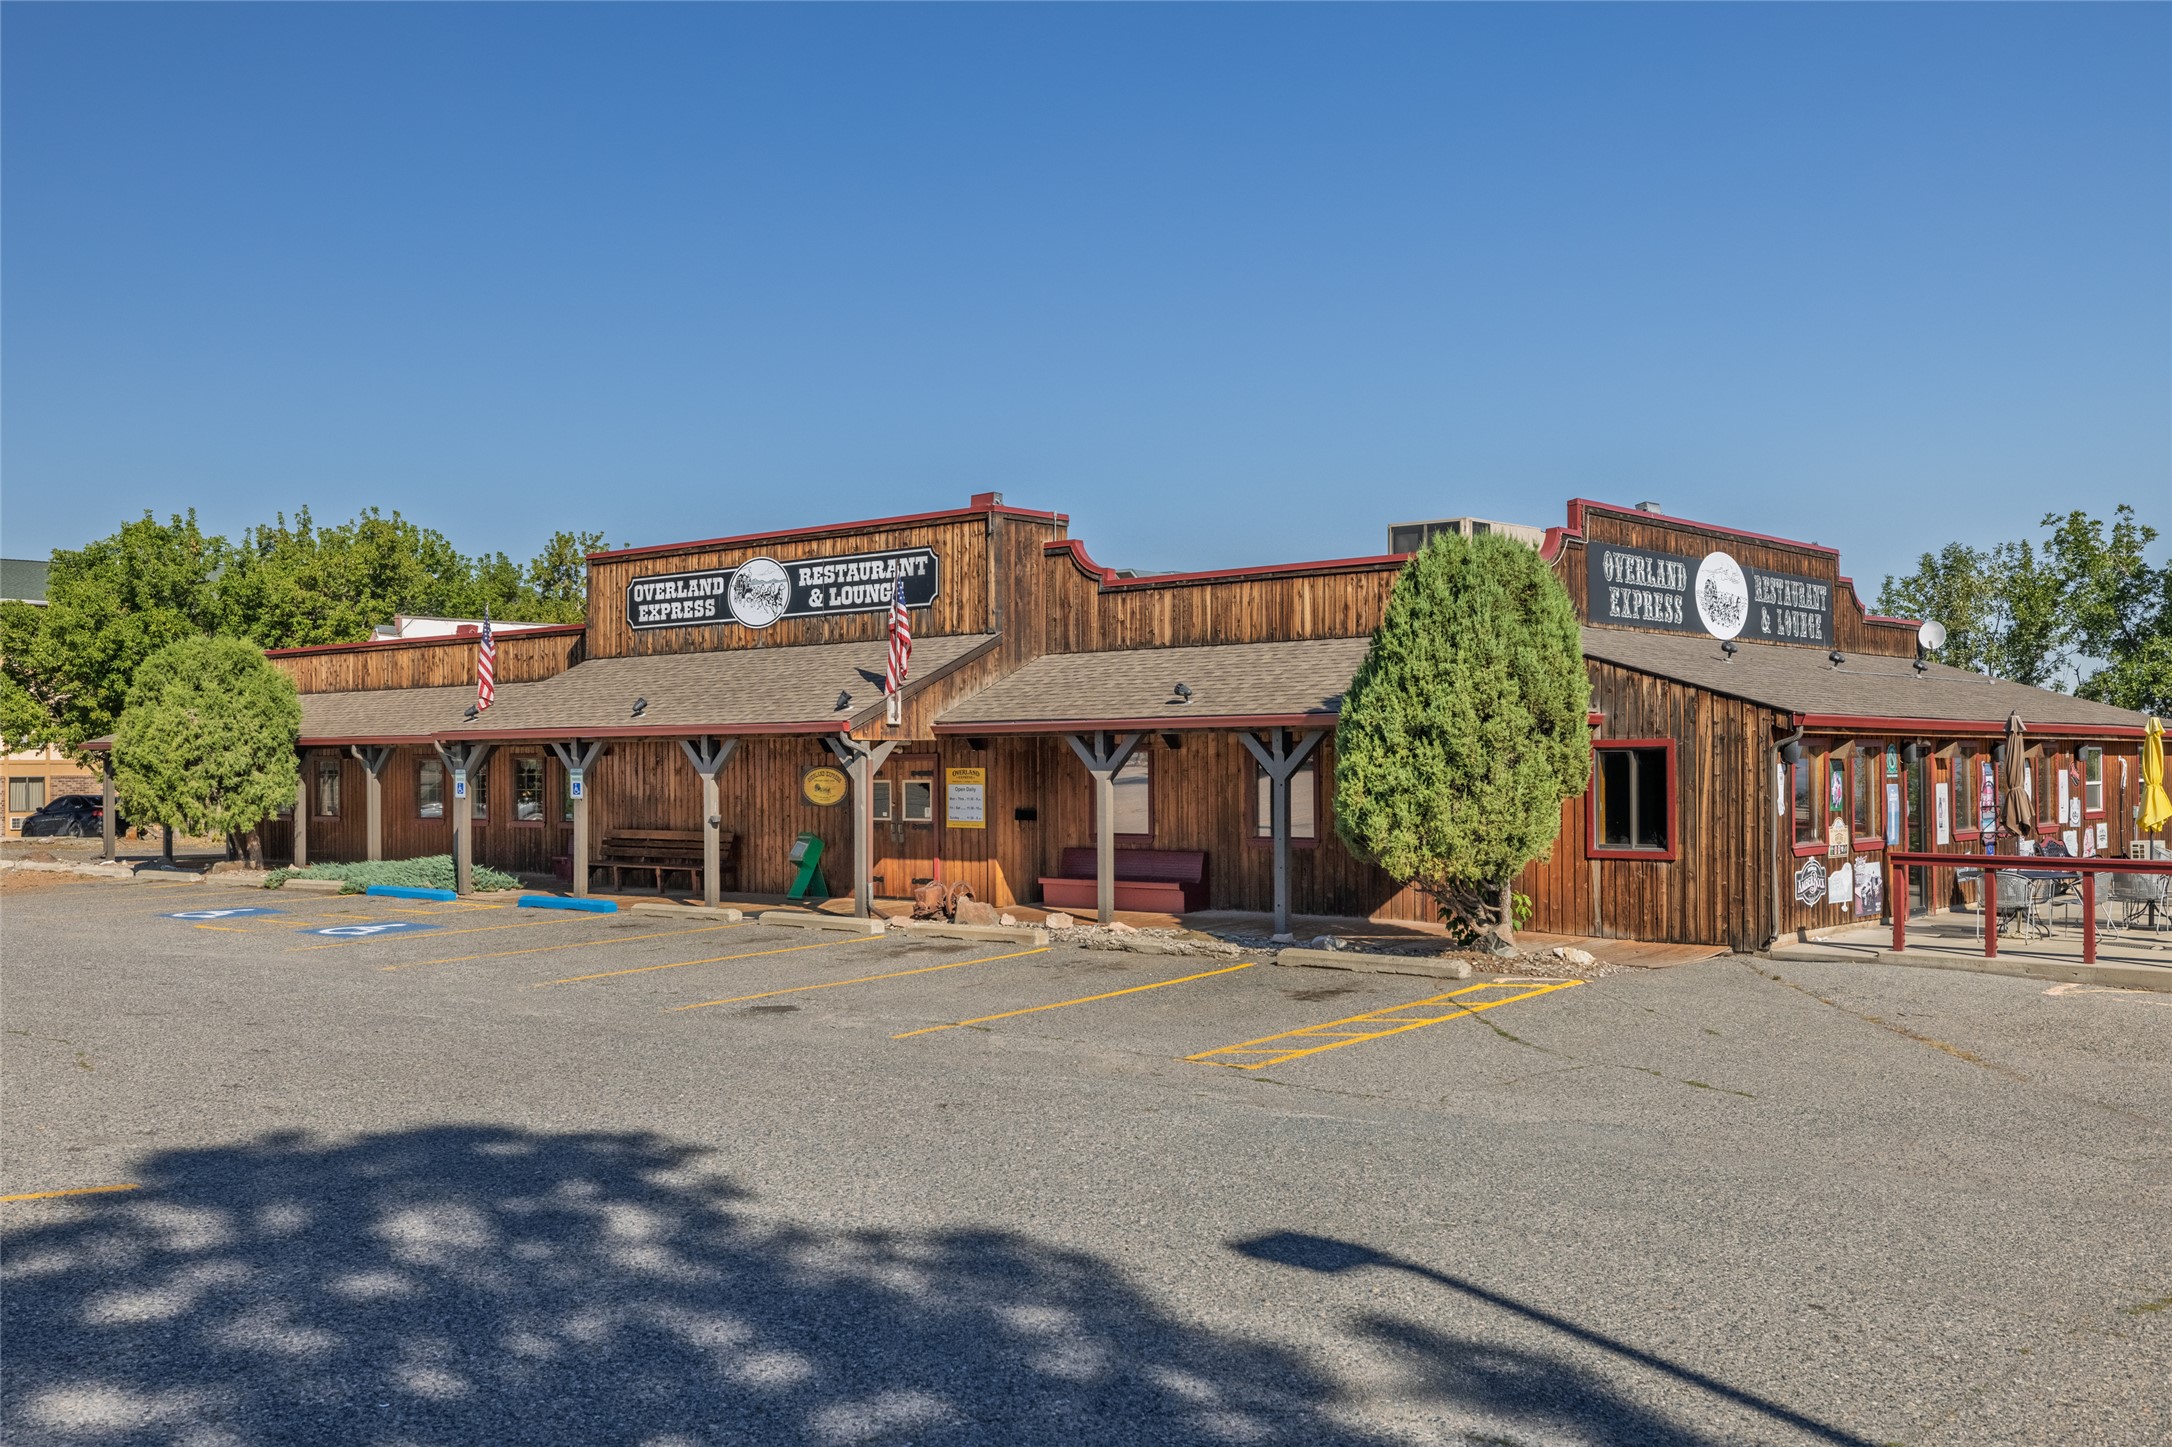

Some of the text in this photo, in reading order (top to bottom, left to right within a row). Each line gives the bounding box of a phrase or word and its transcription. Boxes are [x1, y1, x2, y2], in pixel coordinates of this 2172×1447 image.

[798, 555, 929, 587] RESTAURANT
[1602, 550, 1687, 592] OVERLAND
[633, 576, 725, 603] OVERLAND
[809, 588, 823, 608] &
[1608, 586, 1683, 625] EXPRESS
[1753, 574, 1827, 612] RESTAURANT
[638, 598, 716, 622] EXPRESS
[1760, 606, 1823, 640] & LOUNGE
[952, 769, 980, 777] OVERLAND
